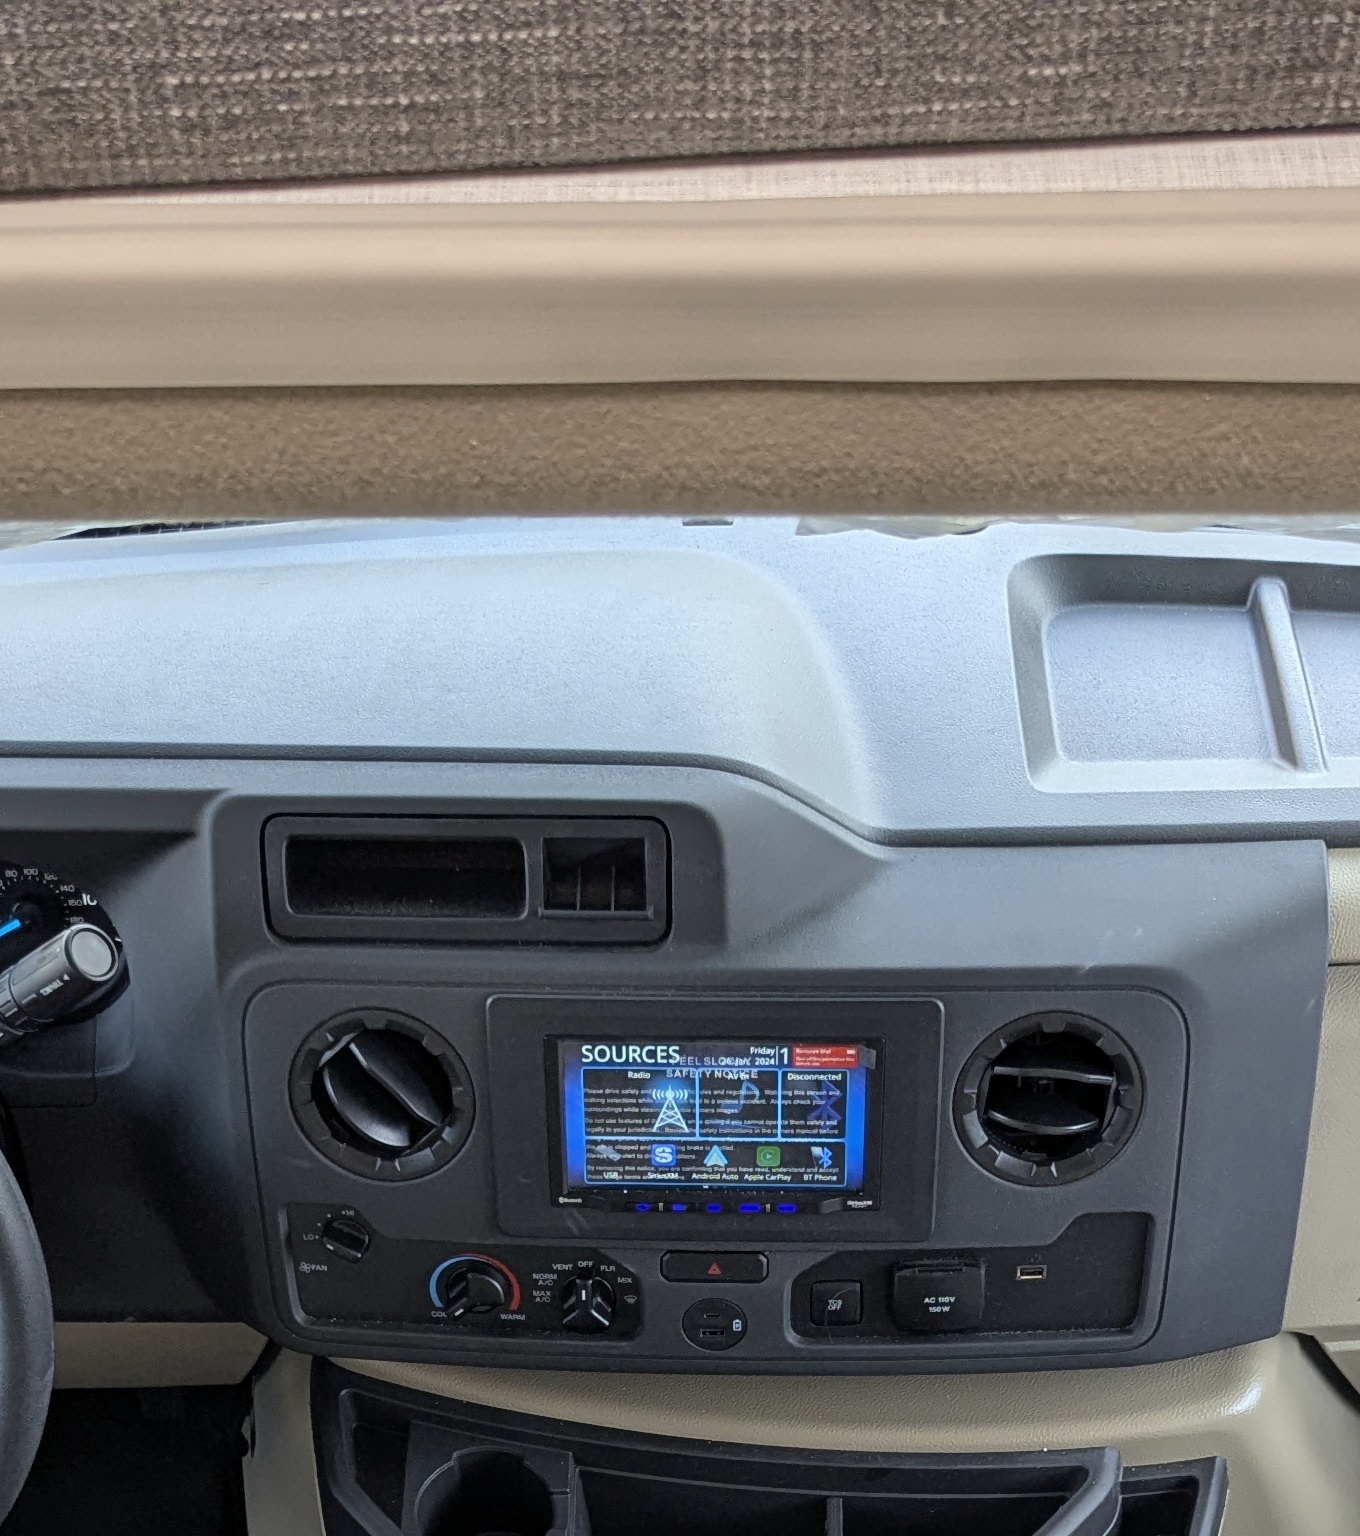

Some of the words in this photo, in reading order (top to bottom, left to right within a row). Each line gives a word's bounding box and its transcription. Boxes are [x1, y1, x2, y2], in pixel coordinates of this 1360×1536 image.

[23, 868, 39, 876] 100
[581, 1045, 680, 1063] SOURCES
[750, 1046, 775, 1056] Friday
[755, 1058, 775, 1066] 2024
[627, 1071, 651, 1079] Radio
[787, 1073, 842, 1081] Disconnected
[744, 1174, 764, 1182] Apple
[765, 1174, 792, 1182] CarPlay
[302, 1233, 315, 1241] LO
[311, 1264, 328, 1272] FAN
[552, 1263, 574, 1271] VENT
[577, 1260, 594, 1268] OFF
[600, 1265, 616, 1273] FLR
[532, 1273, 558, 1281] NORM
[537, 1279, 554, 1287] A/C
[500, 1313, 526, 1321] WARM
